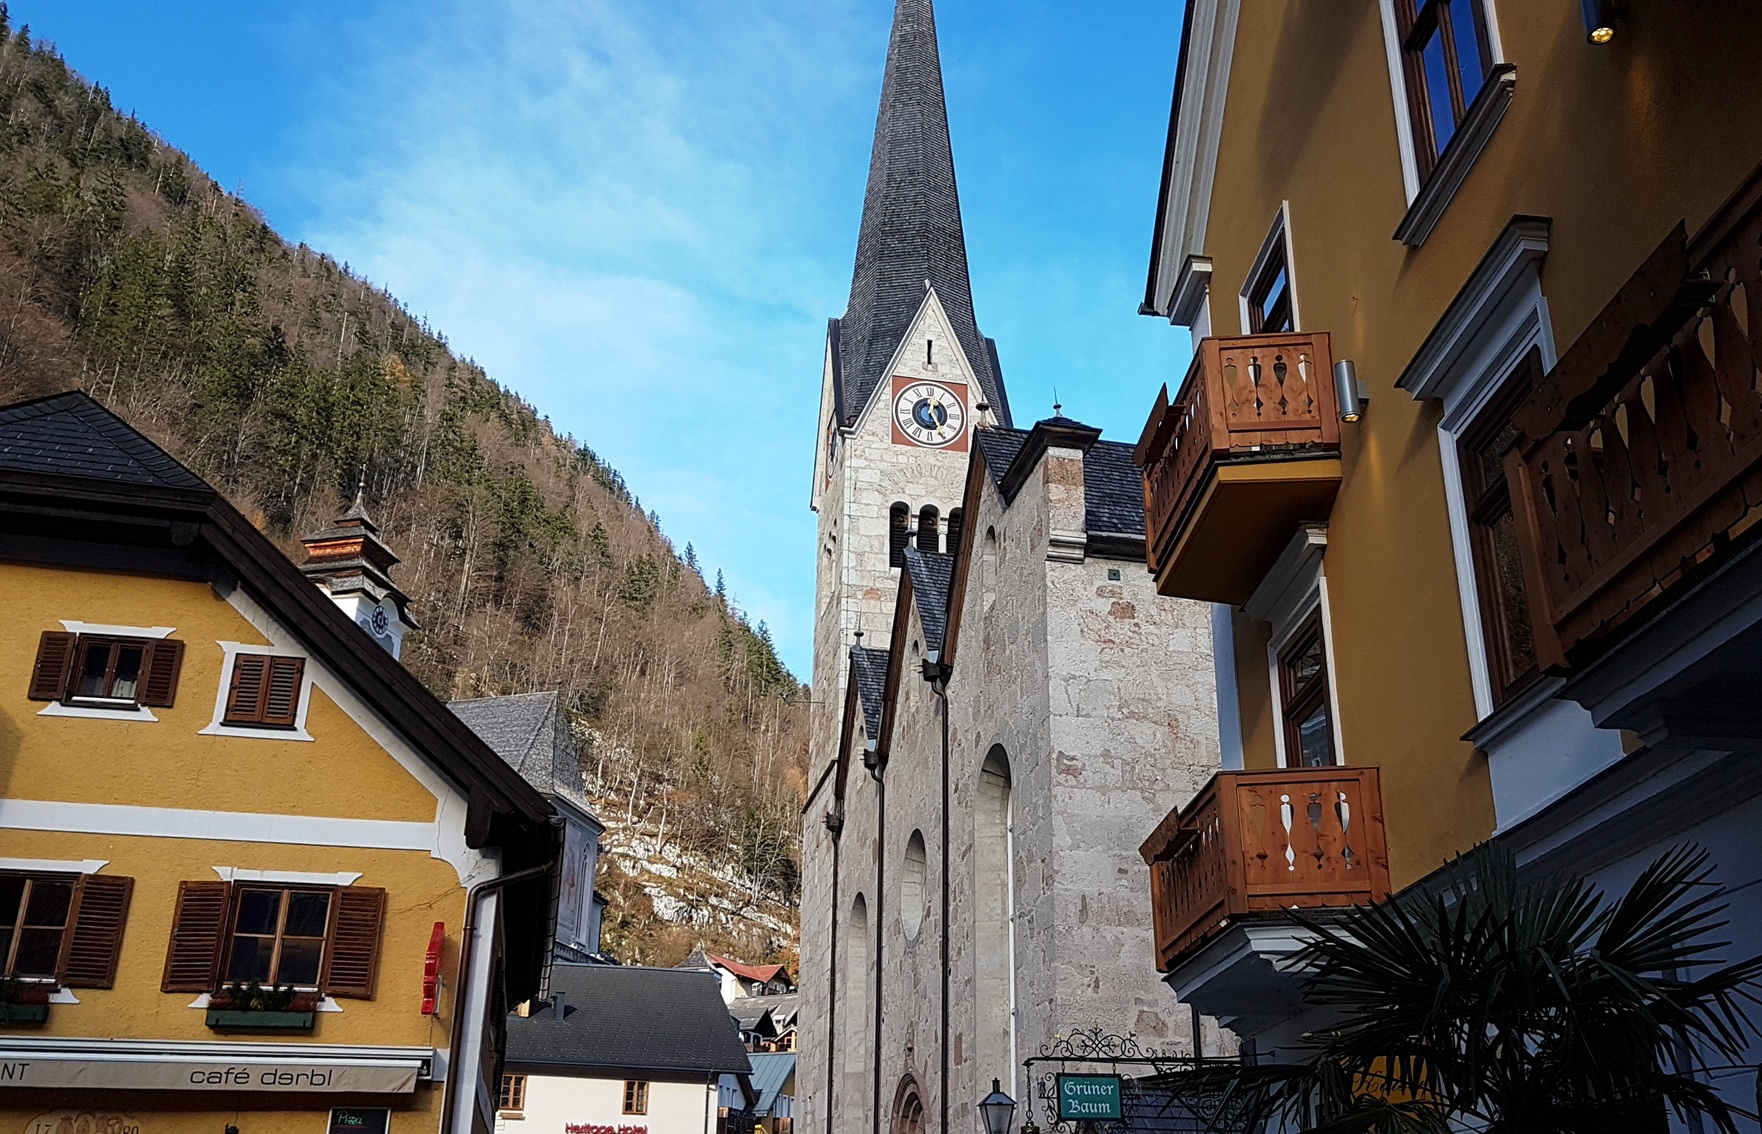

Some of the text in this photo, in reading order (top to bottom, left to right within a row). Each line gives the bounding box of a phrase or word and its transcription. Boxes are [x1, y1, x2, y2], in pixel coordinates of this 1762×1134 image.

[190, 1067, 251, 1084] café
[1064, 1080, 1114, 1096] Grüner
[1068, 1099, 1111, 1114] Baum
[618, 1124, 648, 1134] Hotel
